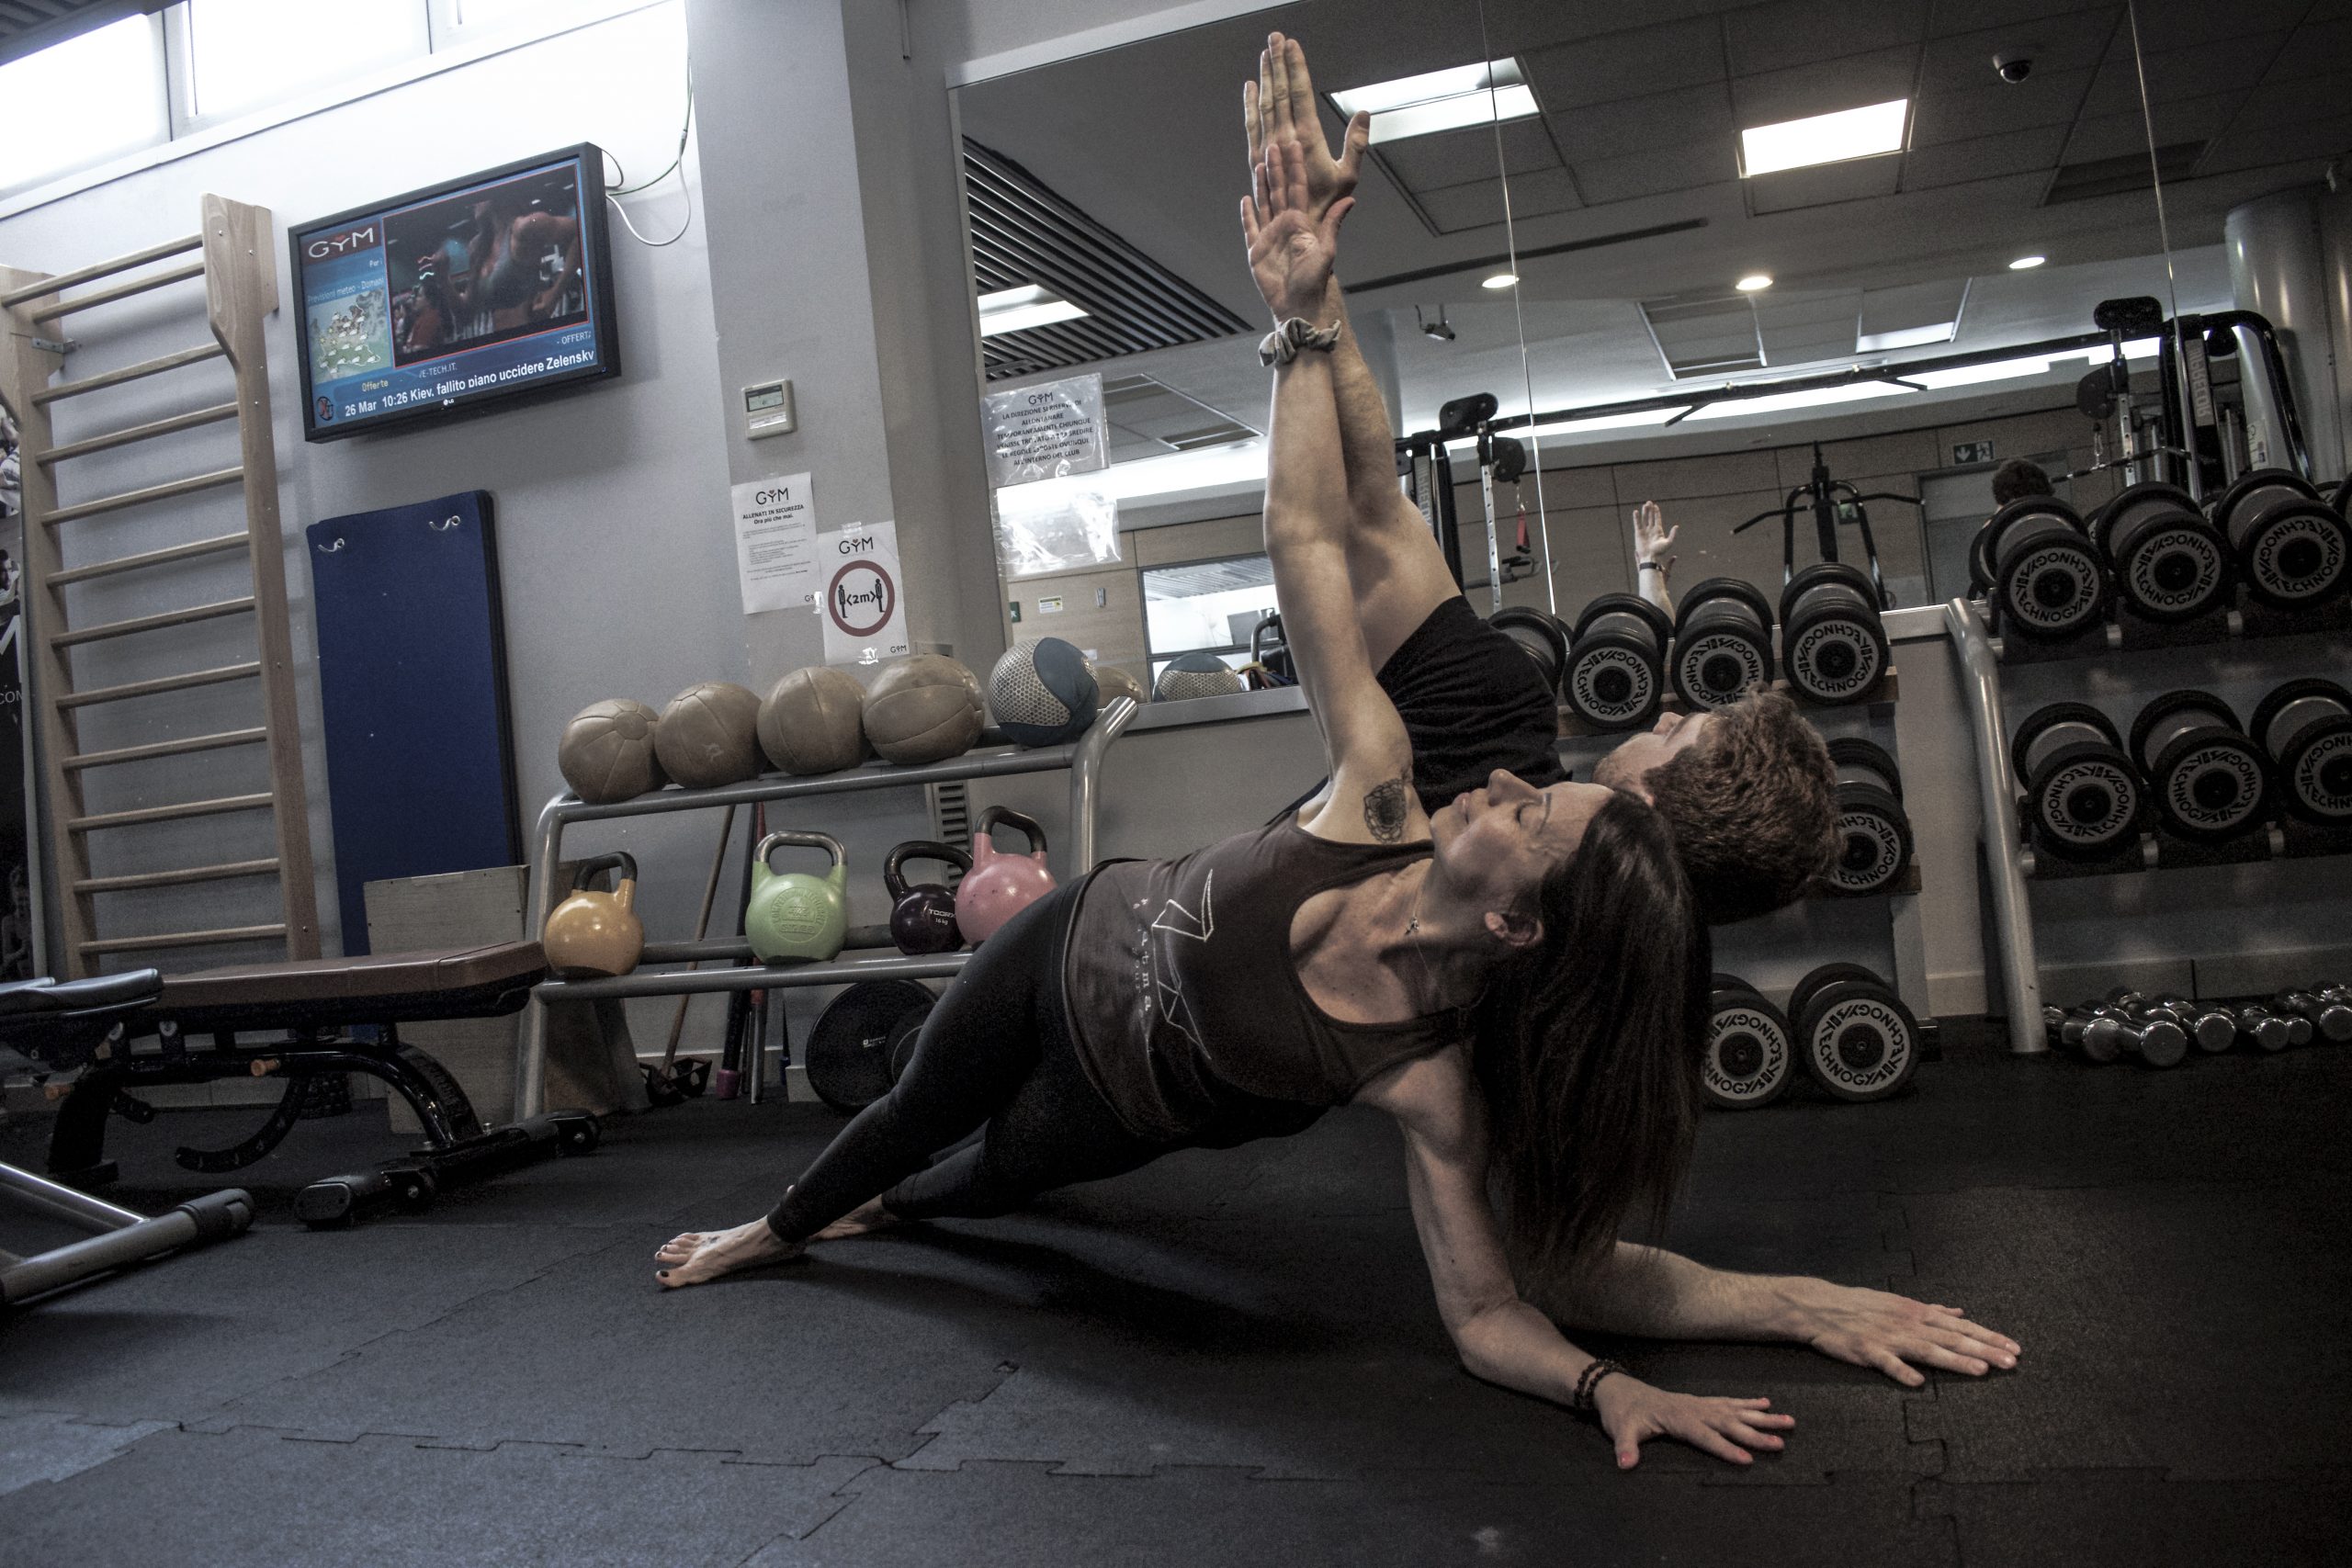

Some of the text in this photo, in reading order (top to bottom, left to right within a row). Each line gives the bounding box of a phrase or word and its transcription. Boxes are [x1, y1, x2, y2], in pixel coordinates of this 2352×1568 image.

[309, 227, 374, 258] GYM
[337, 285, 356, 295] meteo
[345, 404, 356, 417] 26
[358, 400, 377, 413] Mar
[382, 392, 408, 408] 10:26
[411, 388, 435, 401] Kiev.
[436, 378, 466, 395] fallito
[469, 373, 497, 389] piano
[499, 362, 545, 381] uccidere
[362, 379, 389, 392] Offerte
[1028, 392, 1054, 405] GYM
[1011, 408, 1041, 418] DIREZIONE
[1066, 449, 1080, 457] CLUB
[755, 487, 789, 505] GYM
[742, 511, 767, 520] ALLENATI
[775, 504, 805, 514] SICUREZZA
[838, 536, 874, 555] GYM
[890, 645, 908, 653] GYM
